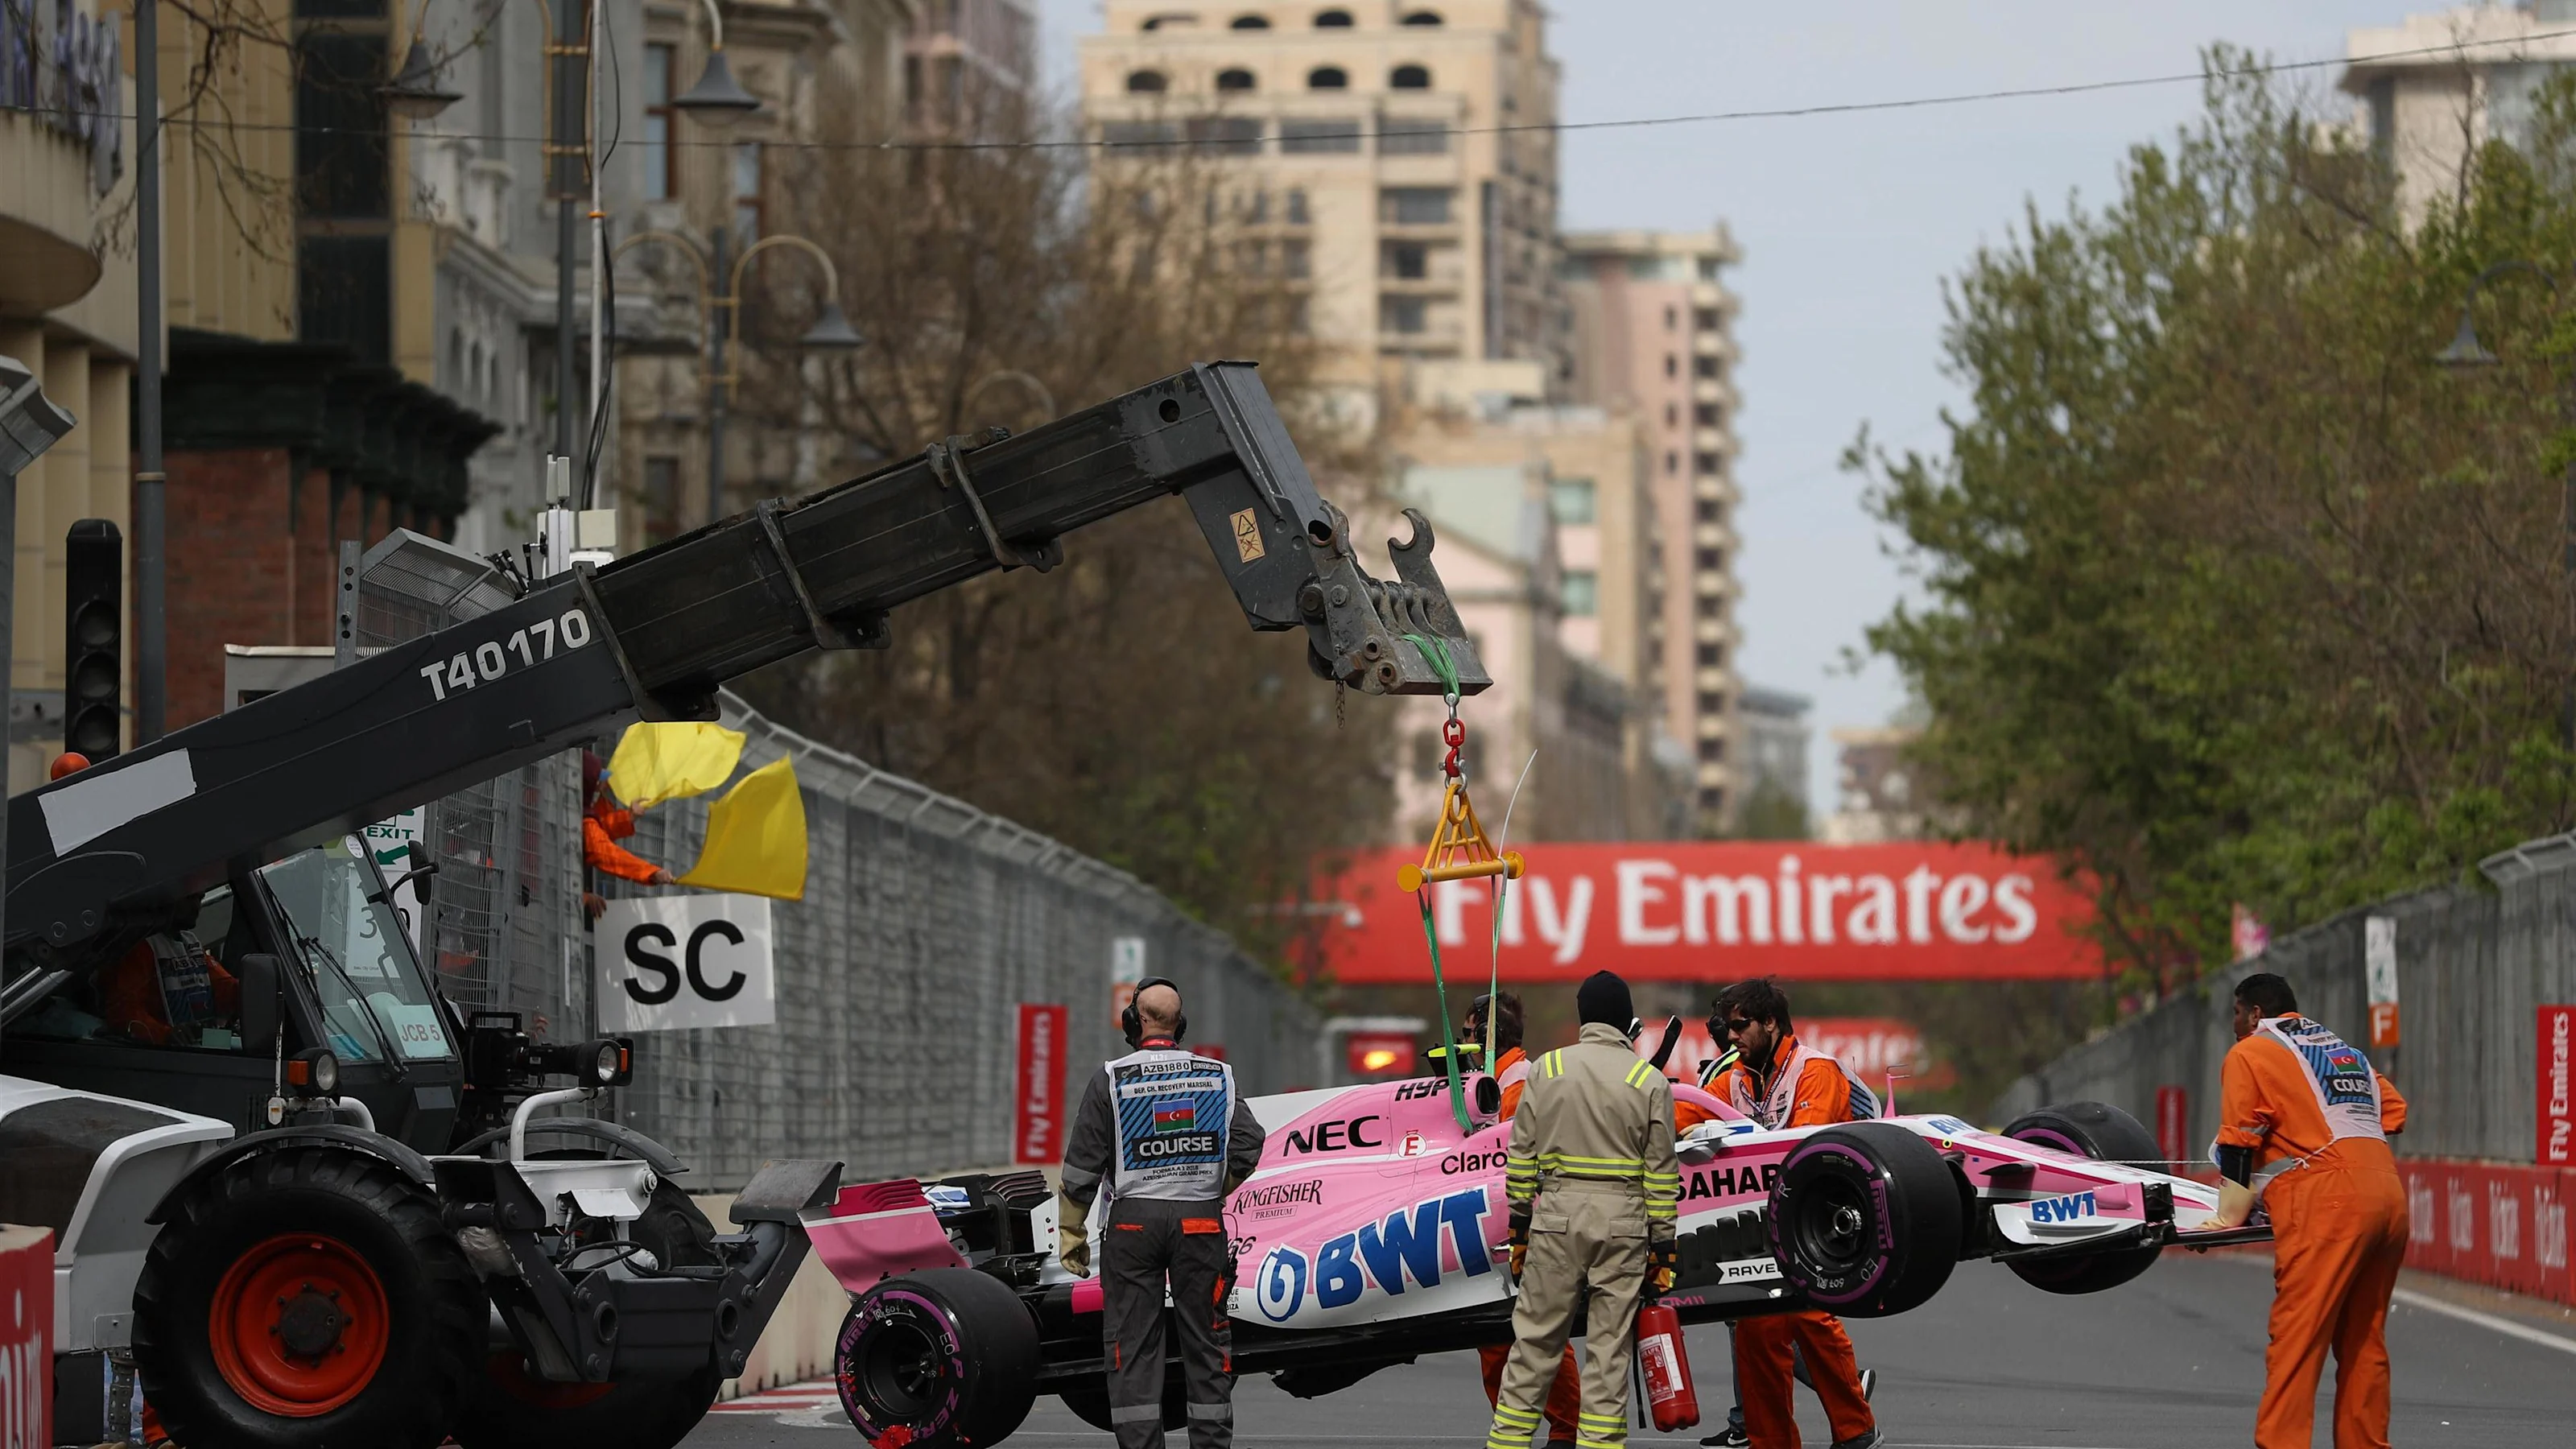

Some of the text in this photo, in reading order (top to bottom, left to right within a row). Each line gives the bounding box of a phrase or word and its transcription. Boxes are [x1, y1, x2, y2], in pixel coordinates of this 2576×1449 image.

[420, 609, 591, 701] T40170
[366, 827, 414, 840] EXIT
[1436, 855, 2039, 965] Fly Emirates
[623, 919, 747, 1005] SC
[402, 1023, 441, 1042] JCB 5
[2372, 1007, 2394, 1044] F
[1143, 1063, 1189, 1074] AZB1880
[2549, 1011, 2570, 1118] Emirates
[1158, 1083, 1186, 1092] RECOVERY
[1187, 1080, 1213, 1088] MARSHAL
[2333, 1078, 2372, 1095] COURS
[1283, 1116, 1382, 1157] NEC
[1927, 1119, 1973, 1134] BW
[2549, 1118, 2573, 1162] Fly
[1139, 1136, 1213, 1157] COURSE
[1441, 1151, 1508, 1175] Claro
[1232, 1179, 1323, 1215] KINGFISHER
[1675, 1164, 1782, 1202] SAHAR
[1254, 1208, 1293, 1220] PREMIUM
[2031, 1191, 2096, 1223] BWT
[1315, 1187, 1492, 1310] BWT
[1728, 1263, 1776, 1278] RAVE
